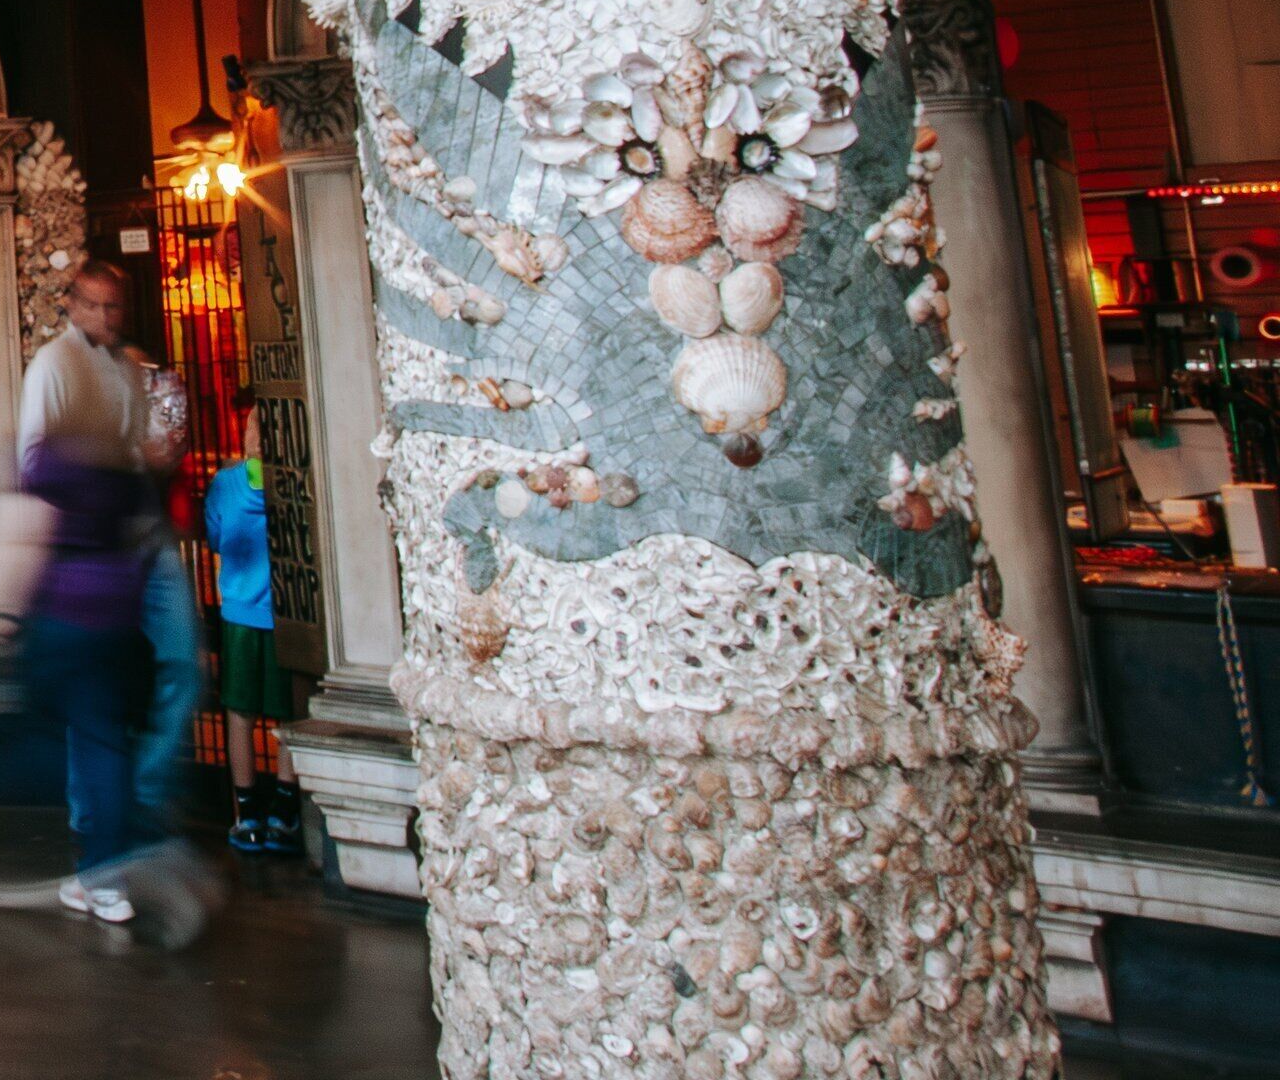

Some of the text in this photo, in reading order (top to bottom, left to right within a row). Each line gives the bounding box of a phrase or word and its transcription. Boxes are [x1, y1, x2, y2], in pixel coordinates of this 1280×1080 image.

[254, 342, 300, 381] FACTORY
[257, 398, 311, 469] BEAD
[274, 467, 313, 504] and
[271, 561, 320, 624] SHOP
